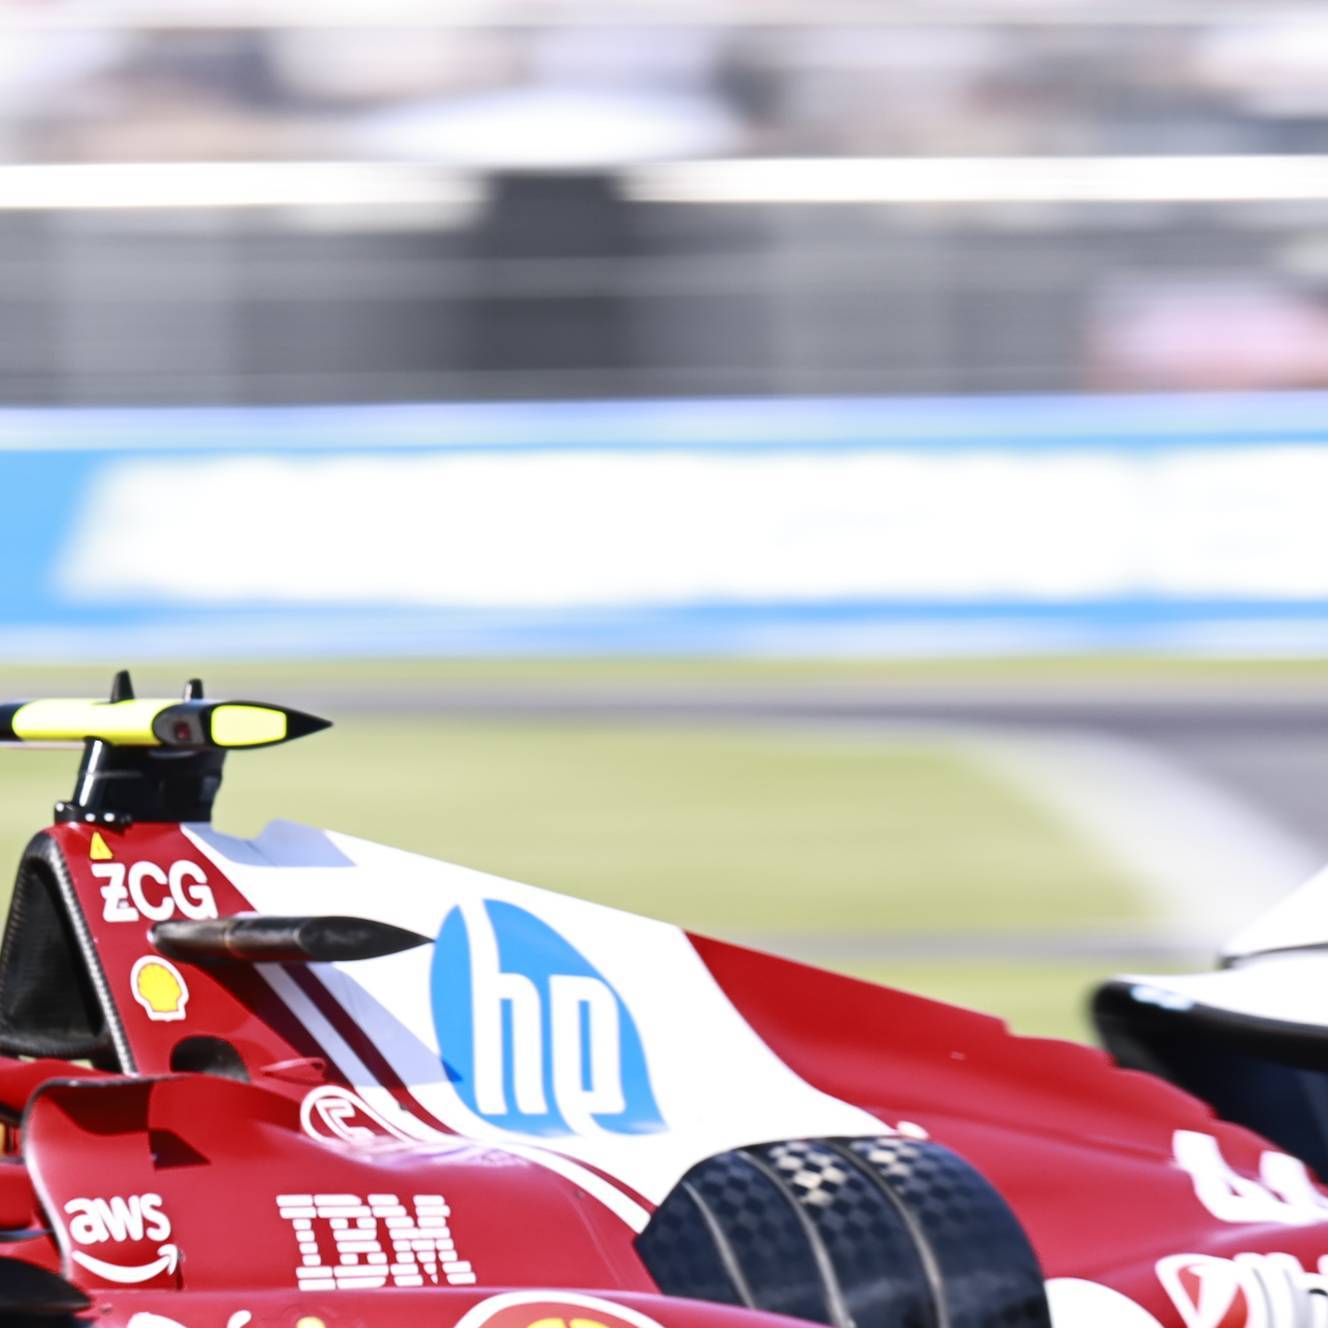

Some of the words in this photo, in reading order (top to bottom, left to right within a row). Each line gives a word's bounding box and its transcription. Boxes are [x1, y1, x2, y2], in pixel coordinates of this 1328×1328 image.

[90, 859, 220, 923] ZCG
[455, 898, 628, 1136] hp
[63, 1193, 172, 1245] aws
[275, 1194, 477, 1291] IBM
